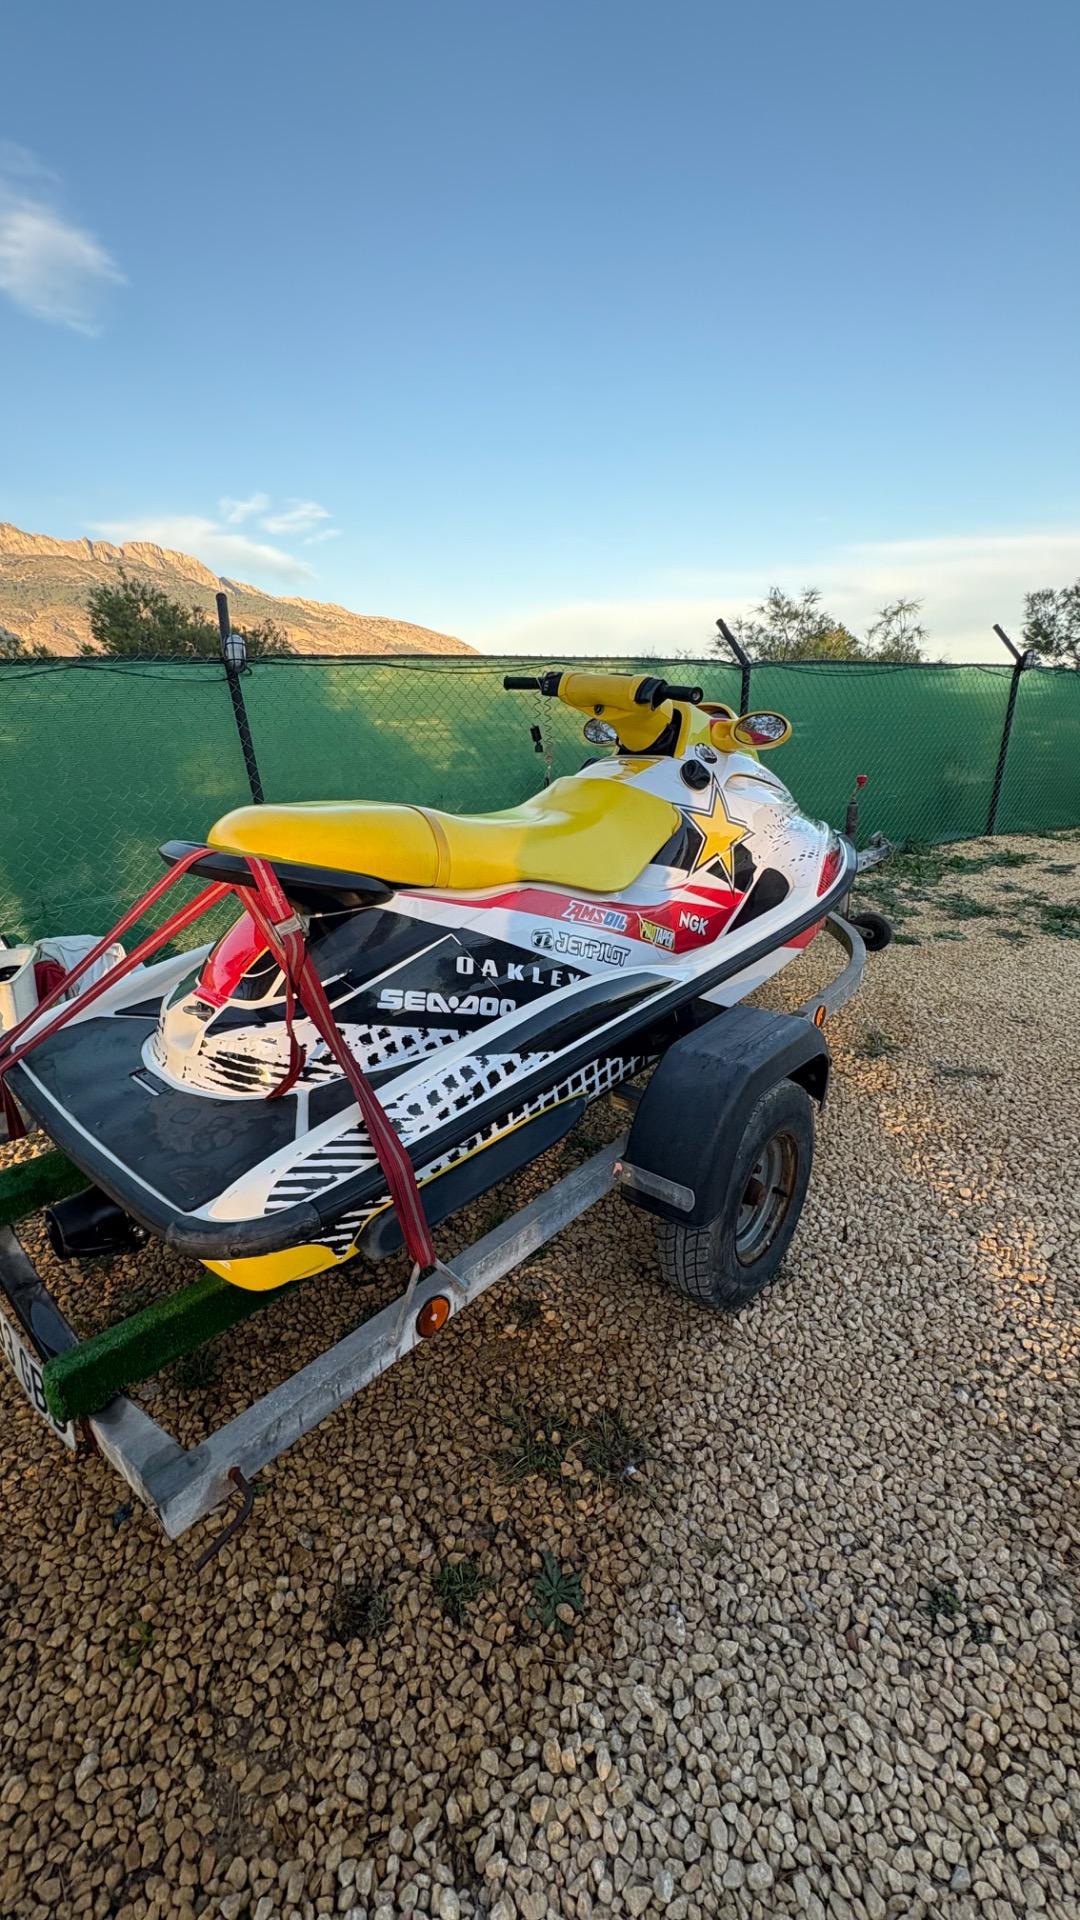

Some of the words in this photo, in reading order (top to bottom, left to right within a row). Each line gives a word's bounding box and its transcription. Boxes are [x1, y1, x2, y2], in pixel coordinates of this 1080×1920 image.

[562, 900, 627, 931] AMSOIL
[679, 910, 709, 936] NGK
[555, 931, 631, 967] JETPILOT
[456, 956, 580, 987] OAKLEY
